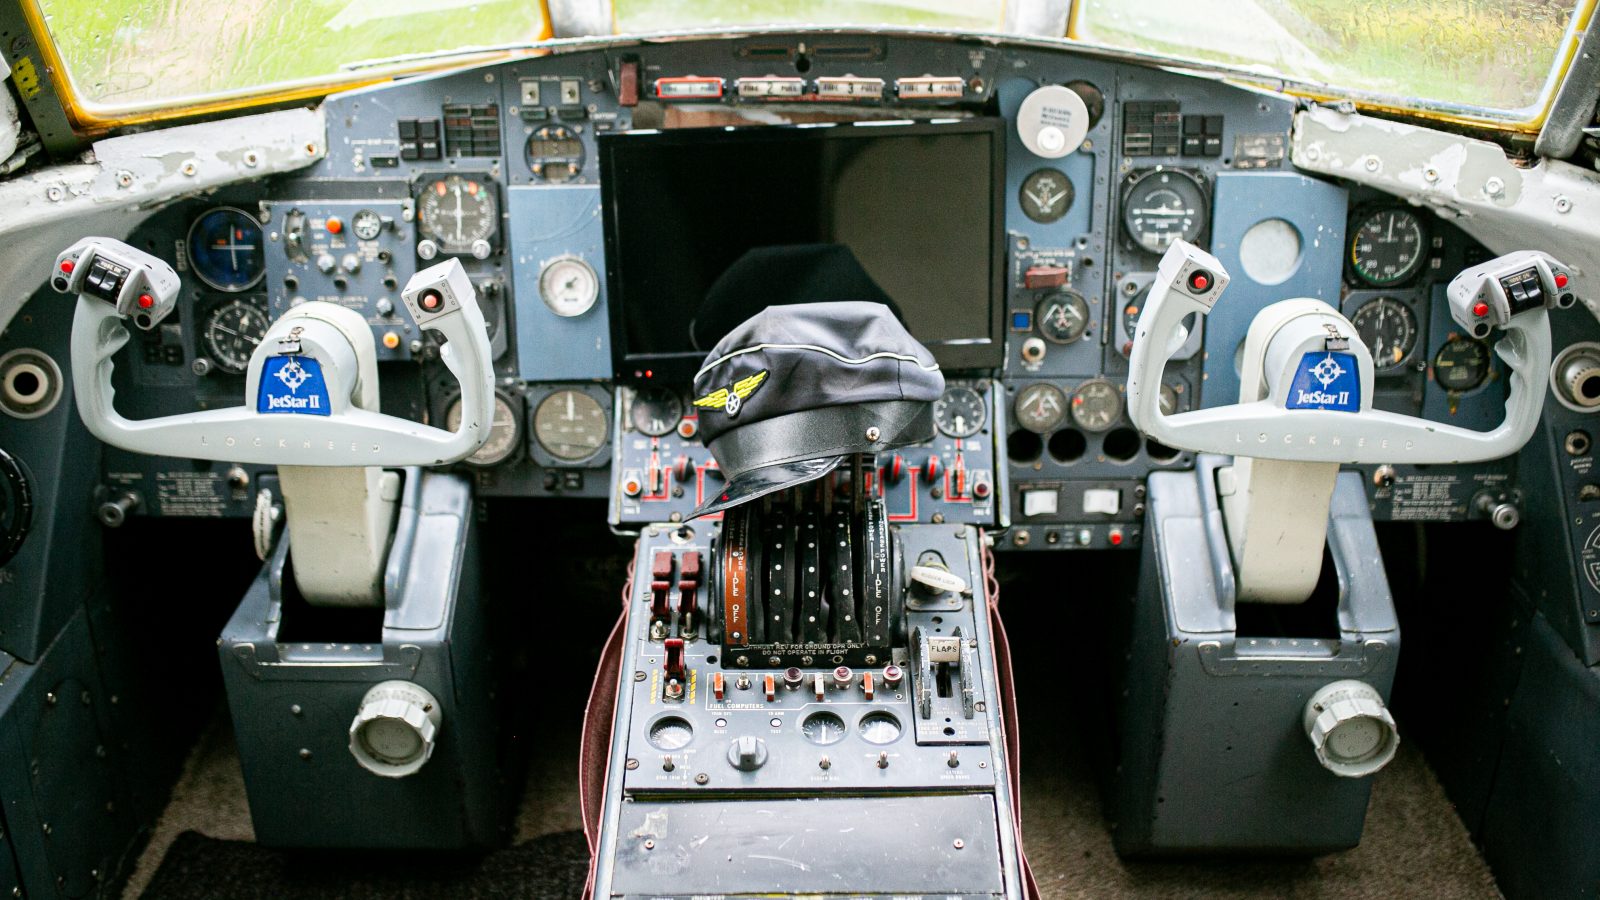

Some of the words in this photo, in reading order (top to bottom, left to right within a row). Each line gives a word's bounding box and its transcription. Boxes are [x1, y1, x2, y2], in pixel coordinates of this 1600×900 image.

[767, 81, 773, 95] 2
[847, 82, 854, 94] 3
[927, 82, 933, 94] 4
[1176, 262, 1192, 285] TRIM
[441, 282, 456, 306] DISC
[1208, 279, 1225, 302] DISC
[406, 296, 421, 319] TRIM
[268, 394, 308, 410] JetStar
[309, 395, 319, 408] II
[1297, 390, 1338, 406] JetStar
[1338, 391, 1349, 405] II
[201, 435, 381, 453] LOCKHEED
[1235, 432, 1415, 450] LOCKHEED
[931, 645, 957, 653] FLAPS
